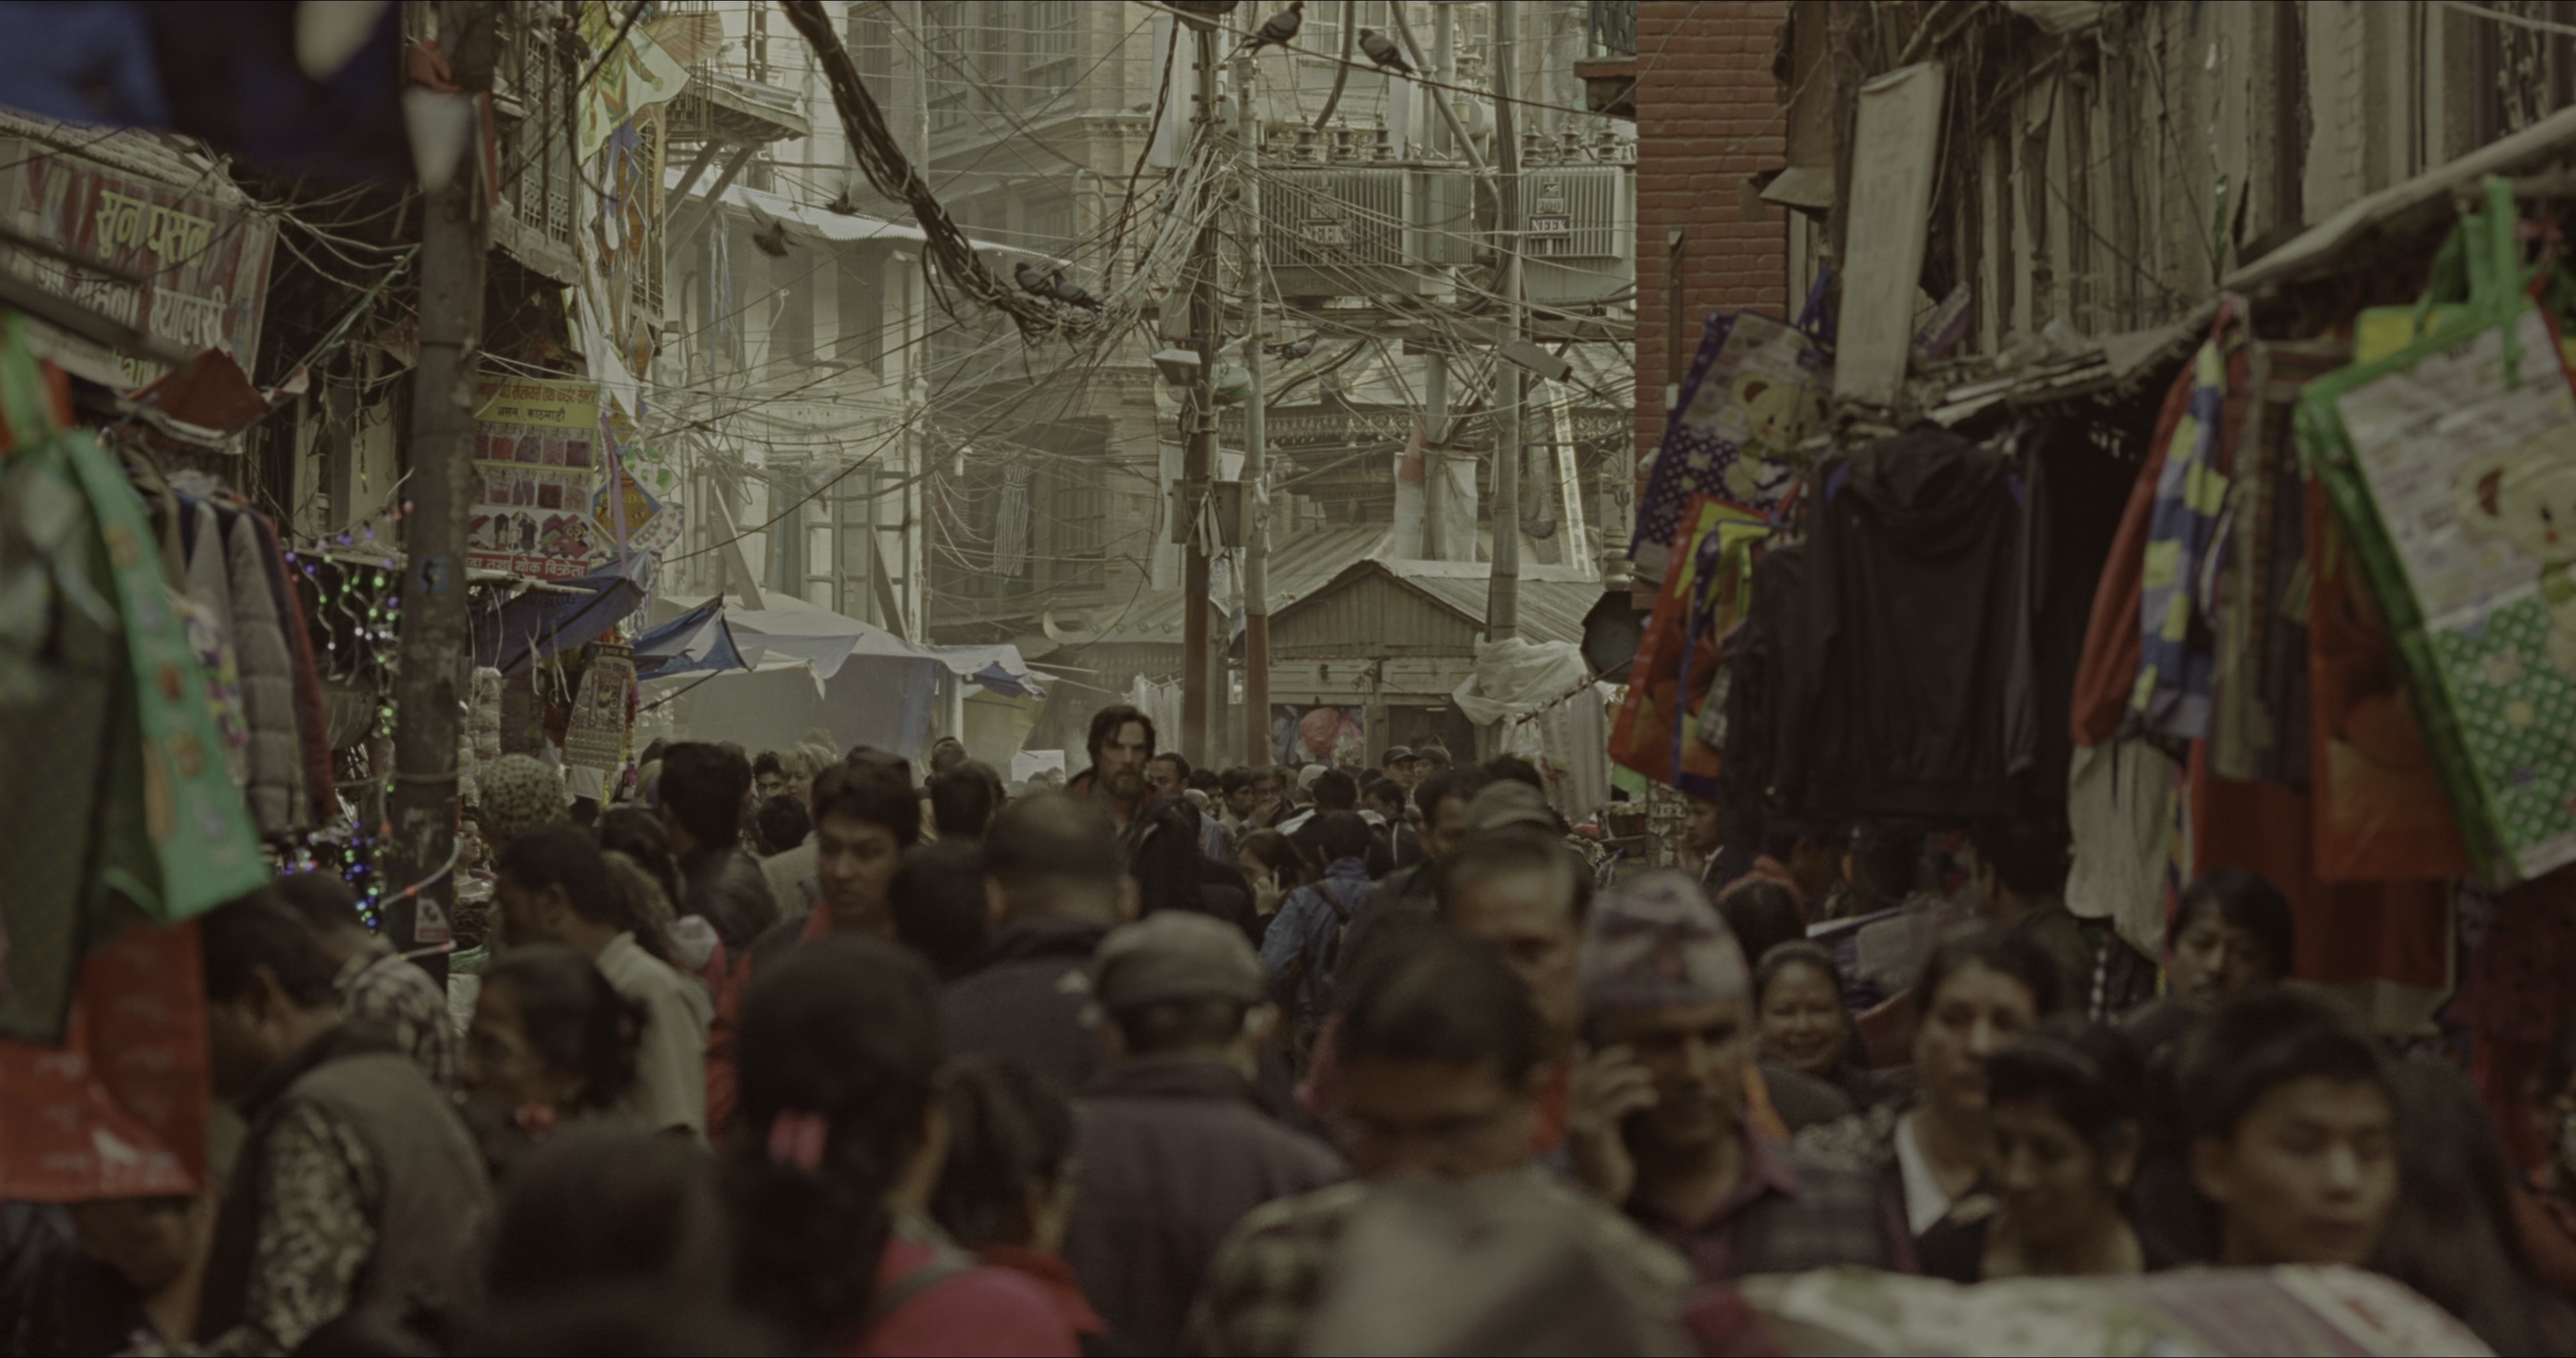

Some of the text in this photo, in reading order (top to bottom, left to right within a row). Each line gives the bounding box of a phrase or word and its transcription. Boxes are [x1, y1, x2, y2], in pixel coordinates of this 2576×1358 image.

[95, 189, 216, 268] सुन पसल
[600, 493, 647, 505] PDA
